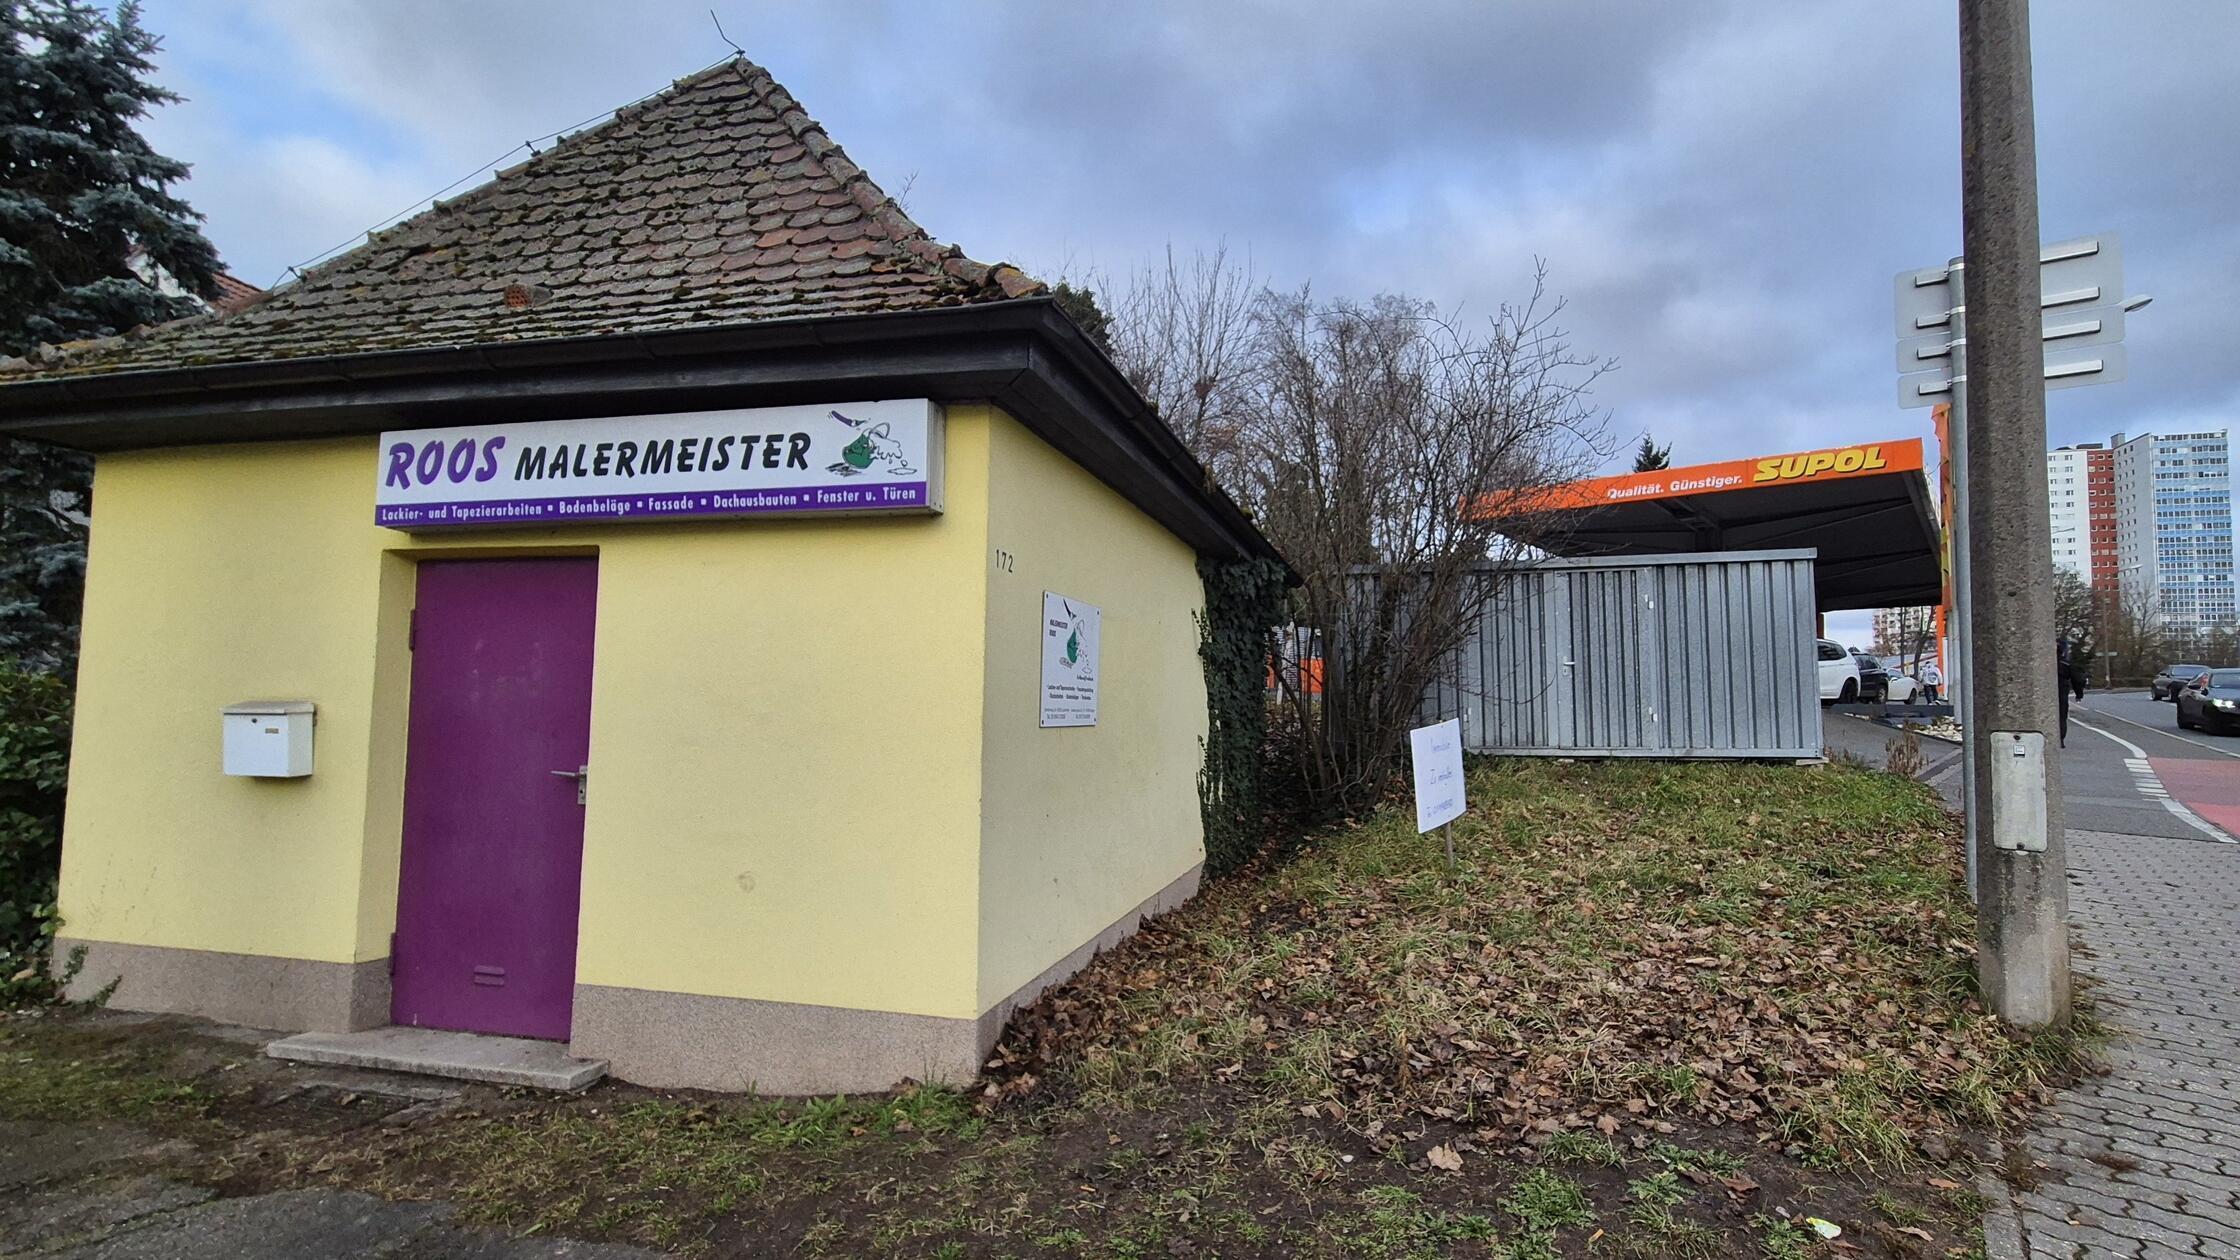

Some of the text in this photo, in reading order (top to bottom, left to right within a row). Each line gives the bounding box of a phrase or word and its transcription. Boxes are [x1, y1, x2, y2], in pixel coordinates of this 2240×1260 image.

[385, 432, 811, 490] ROOS MALERMEISTER
[1753, 446, 1886, 482] SUPOL
[382, 486, 915, 521] Lackier- und Tapezierarbeiten Bodenbeläge Fassade Dachausbauten Fenster u. Türen
[1607, 475, 1743, 499] Qualität. Günstiger.
[996, 549, 1014, 573] 172
